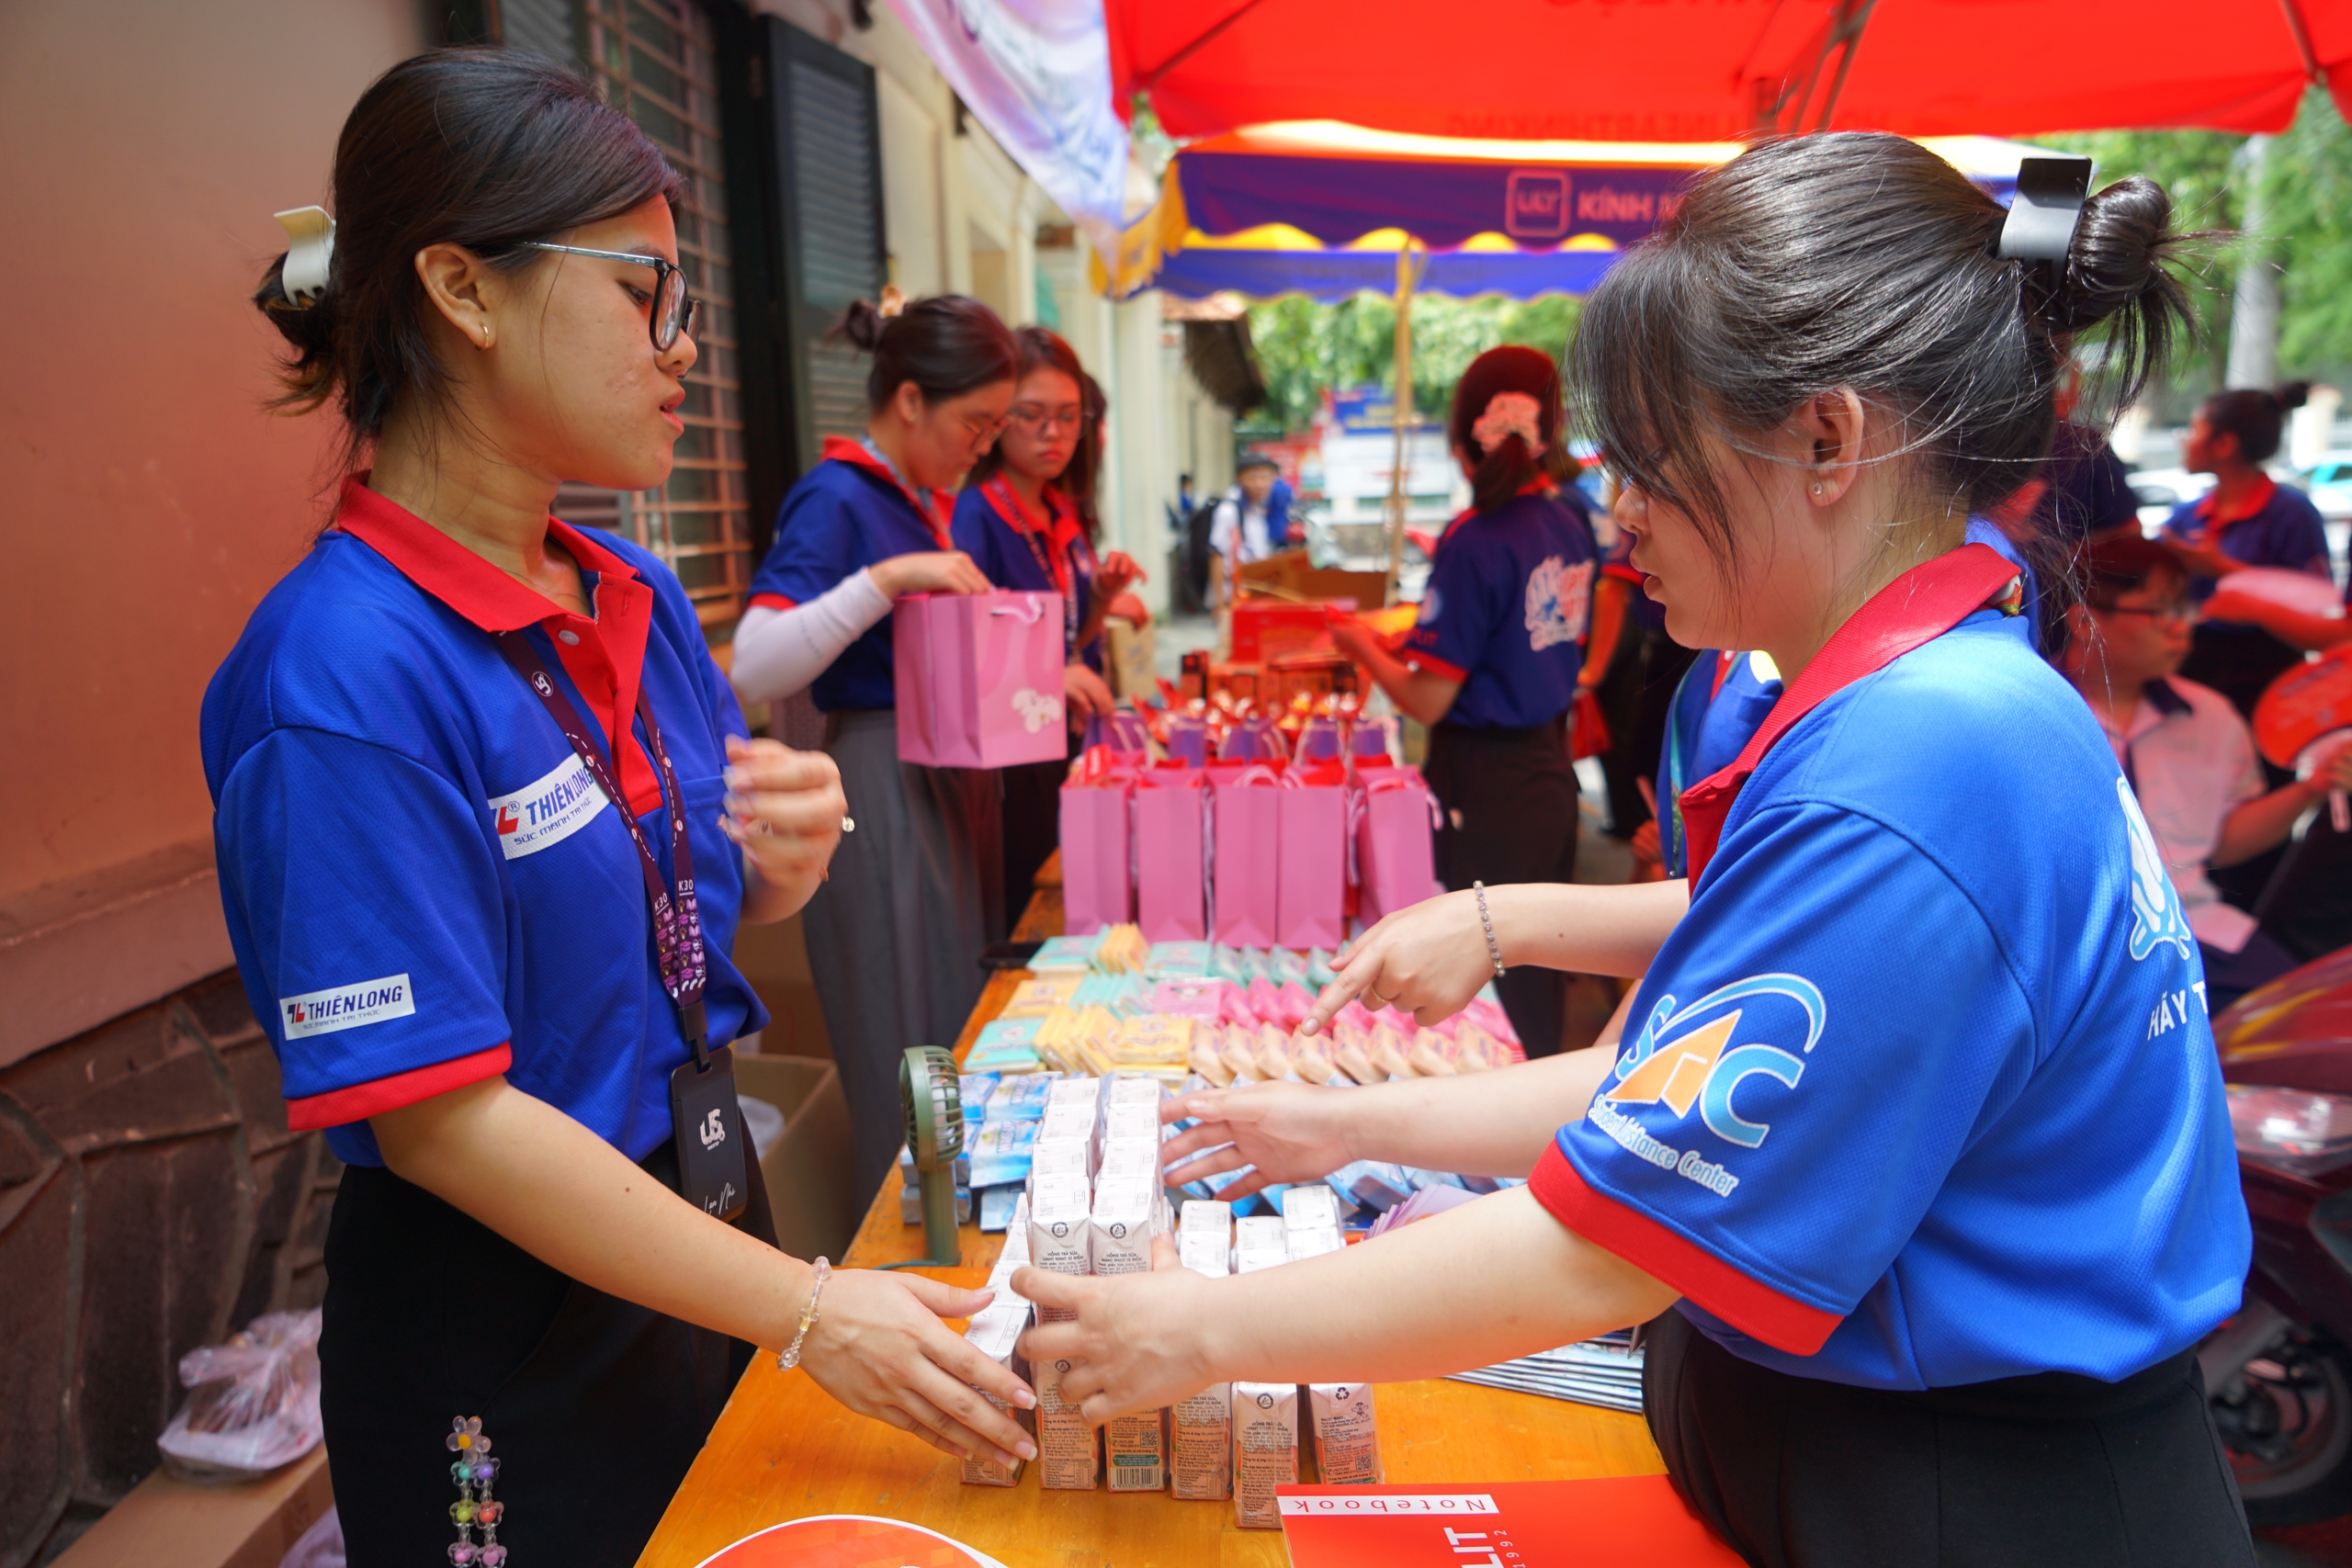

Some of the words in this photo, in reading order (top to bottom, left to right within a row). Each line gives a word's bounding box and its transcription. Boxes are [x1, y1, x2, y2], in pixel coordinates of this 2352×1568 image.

[1577, 186, 1653, 221] KÍNH
[679, 879, 694, 892] K30
[654, 892, 668, 912] K30
[1678, 1150, 1740, 1198] Center
[1294, 1498, 1486, 1513] Notebook
